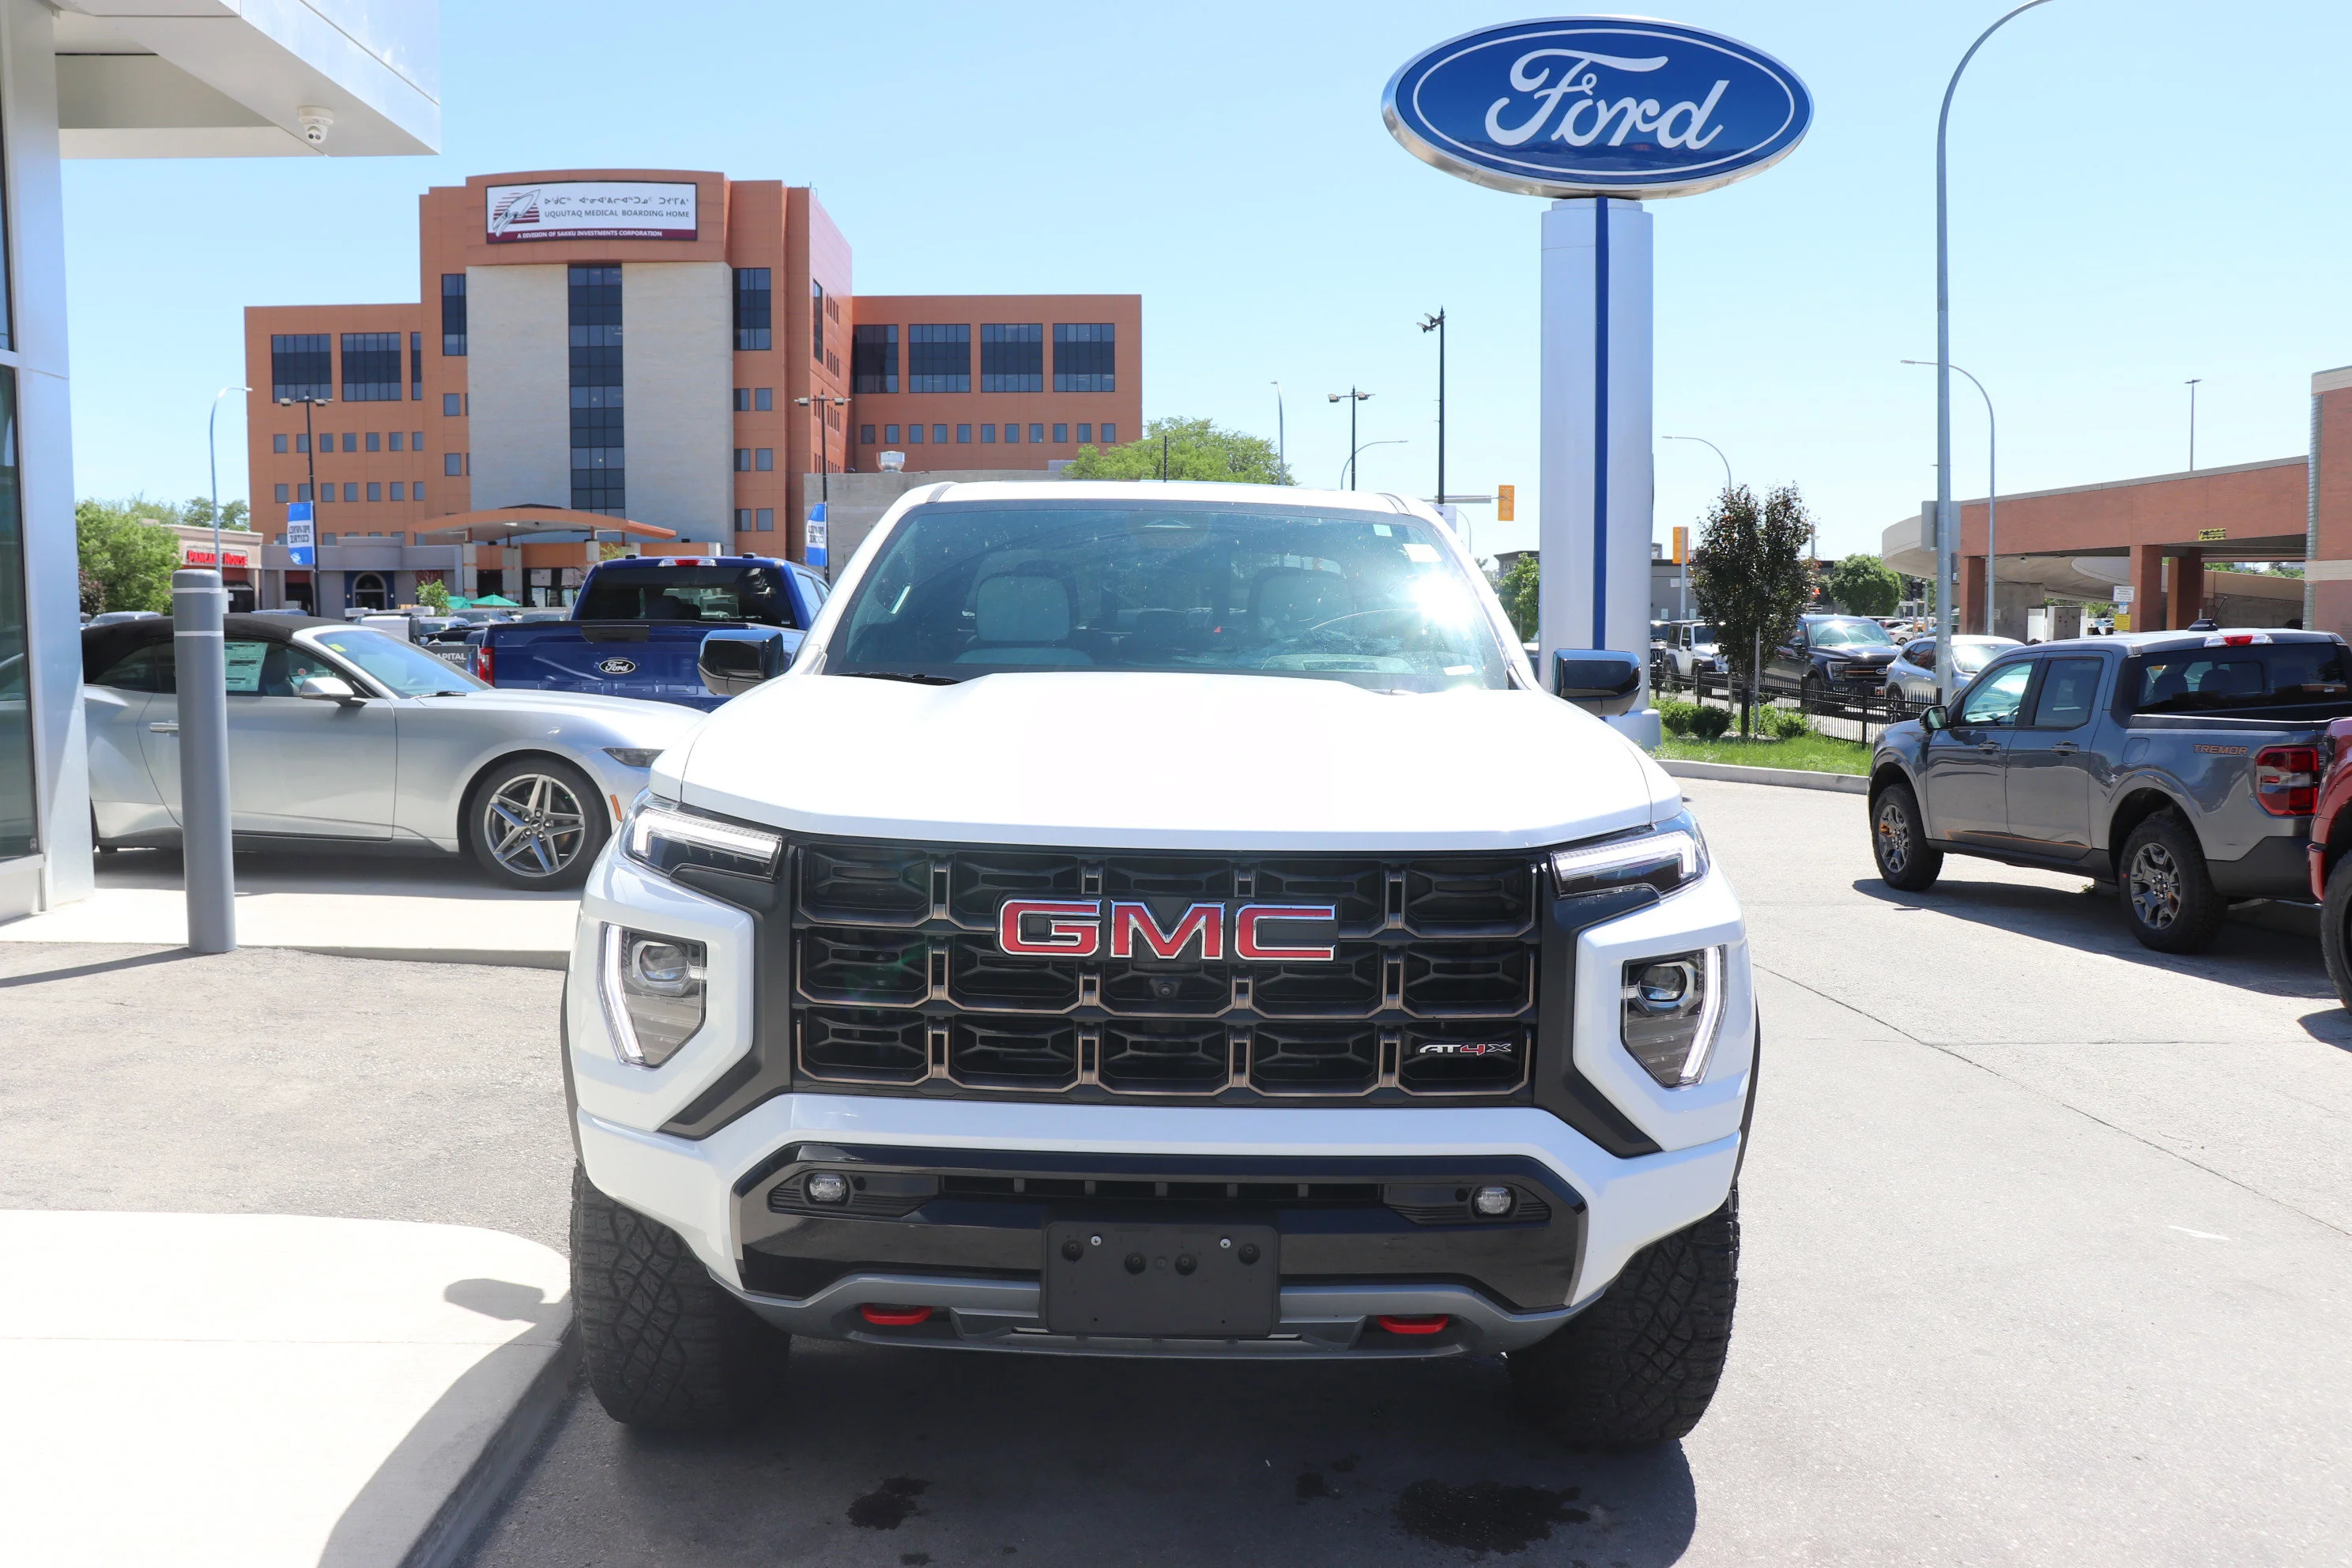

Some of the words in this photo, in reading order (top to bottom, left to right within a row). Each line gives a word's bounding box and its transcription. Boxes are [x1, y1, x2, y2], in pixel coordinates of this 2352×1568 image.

[1485, 48, 1730, 150] Ford
[187, 550, 220, 564] PANCA
[223, 552, 247, 566] HOUSE
[435, 652, 467, 661] APITAL
[605, 661, 629, 672] Ford
[2193, 744, 2248, 756] TREMOR
[999, 899, 1336, 961] GMC
[1419, 1043, 1512, 1056] AT4X
